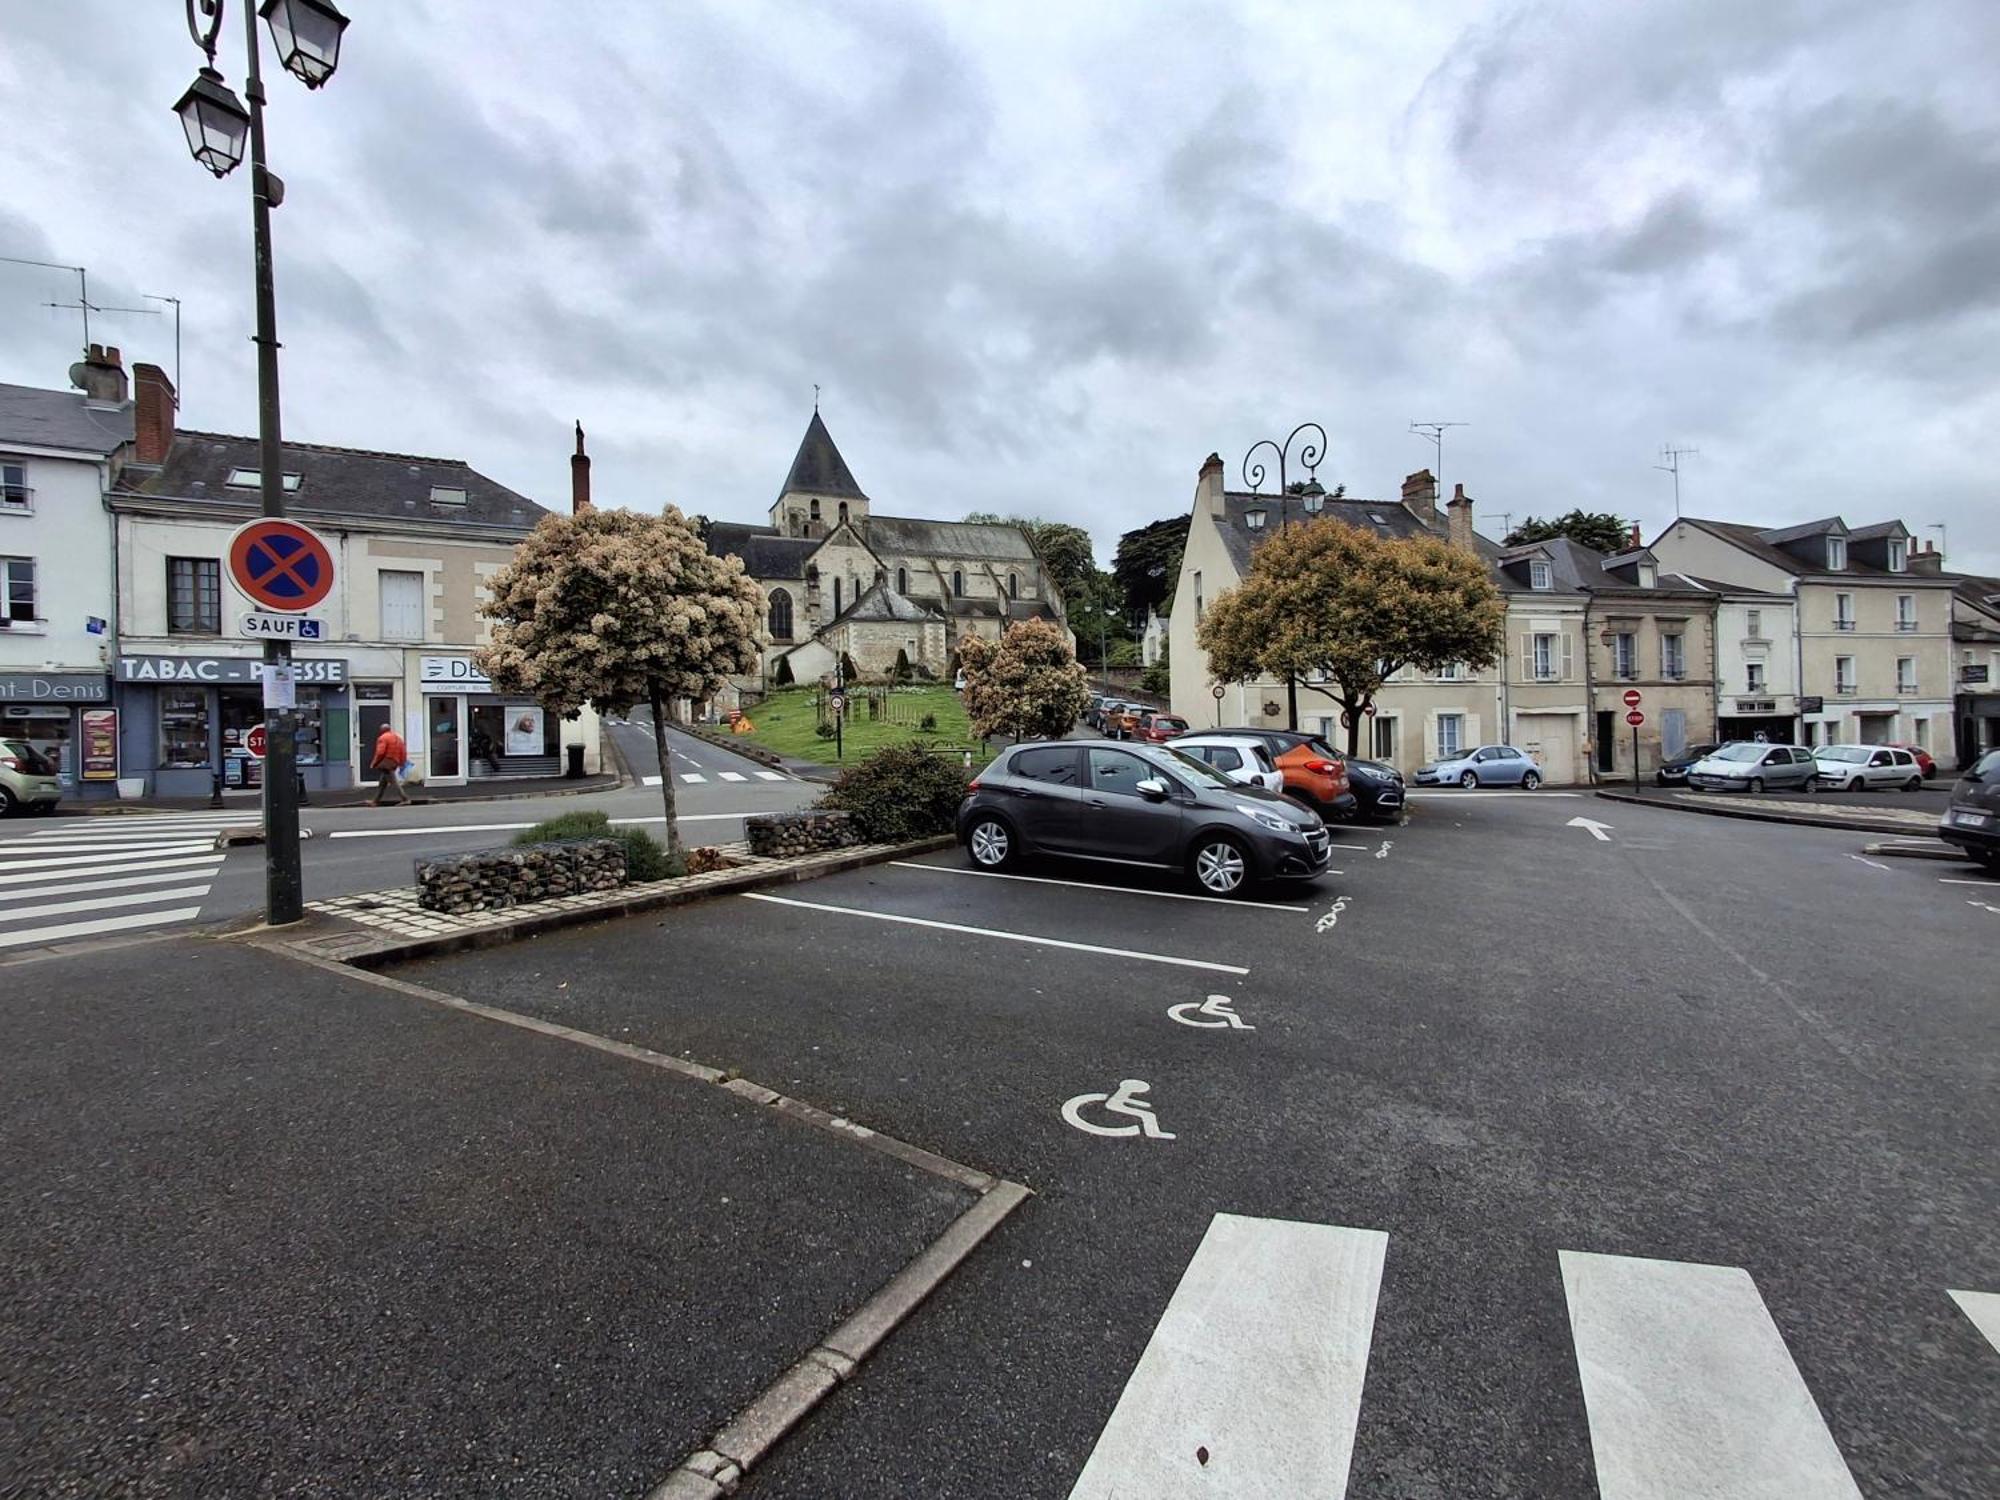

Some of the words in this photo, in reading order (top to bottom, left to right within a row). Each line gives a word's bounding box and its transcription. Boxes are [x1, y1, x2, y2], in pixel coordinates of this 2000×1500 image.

[247, 617, 295, 633] SAUF
[122, 659, 219, 680] TABAC
[250, 662, 341, 681] PESSE
[250, 737, 265, 746] ST
